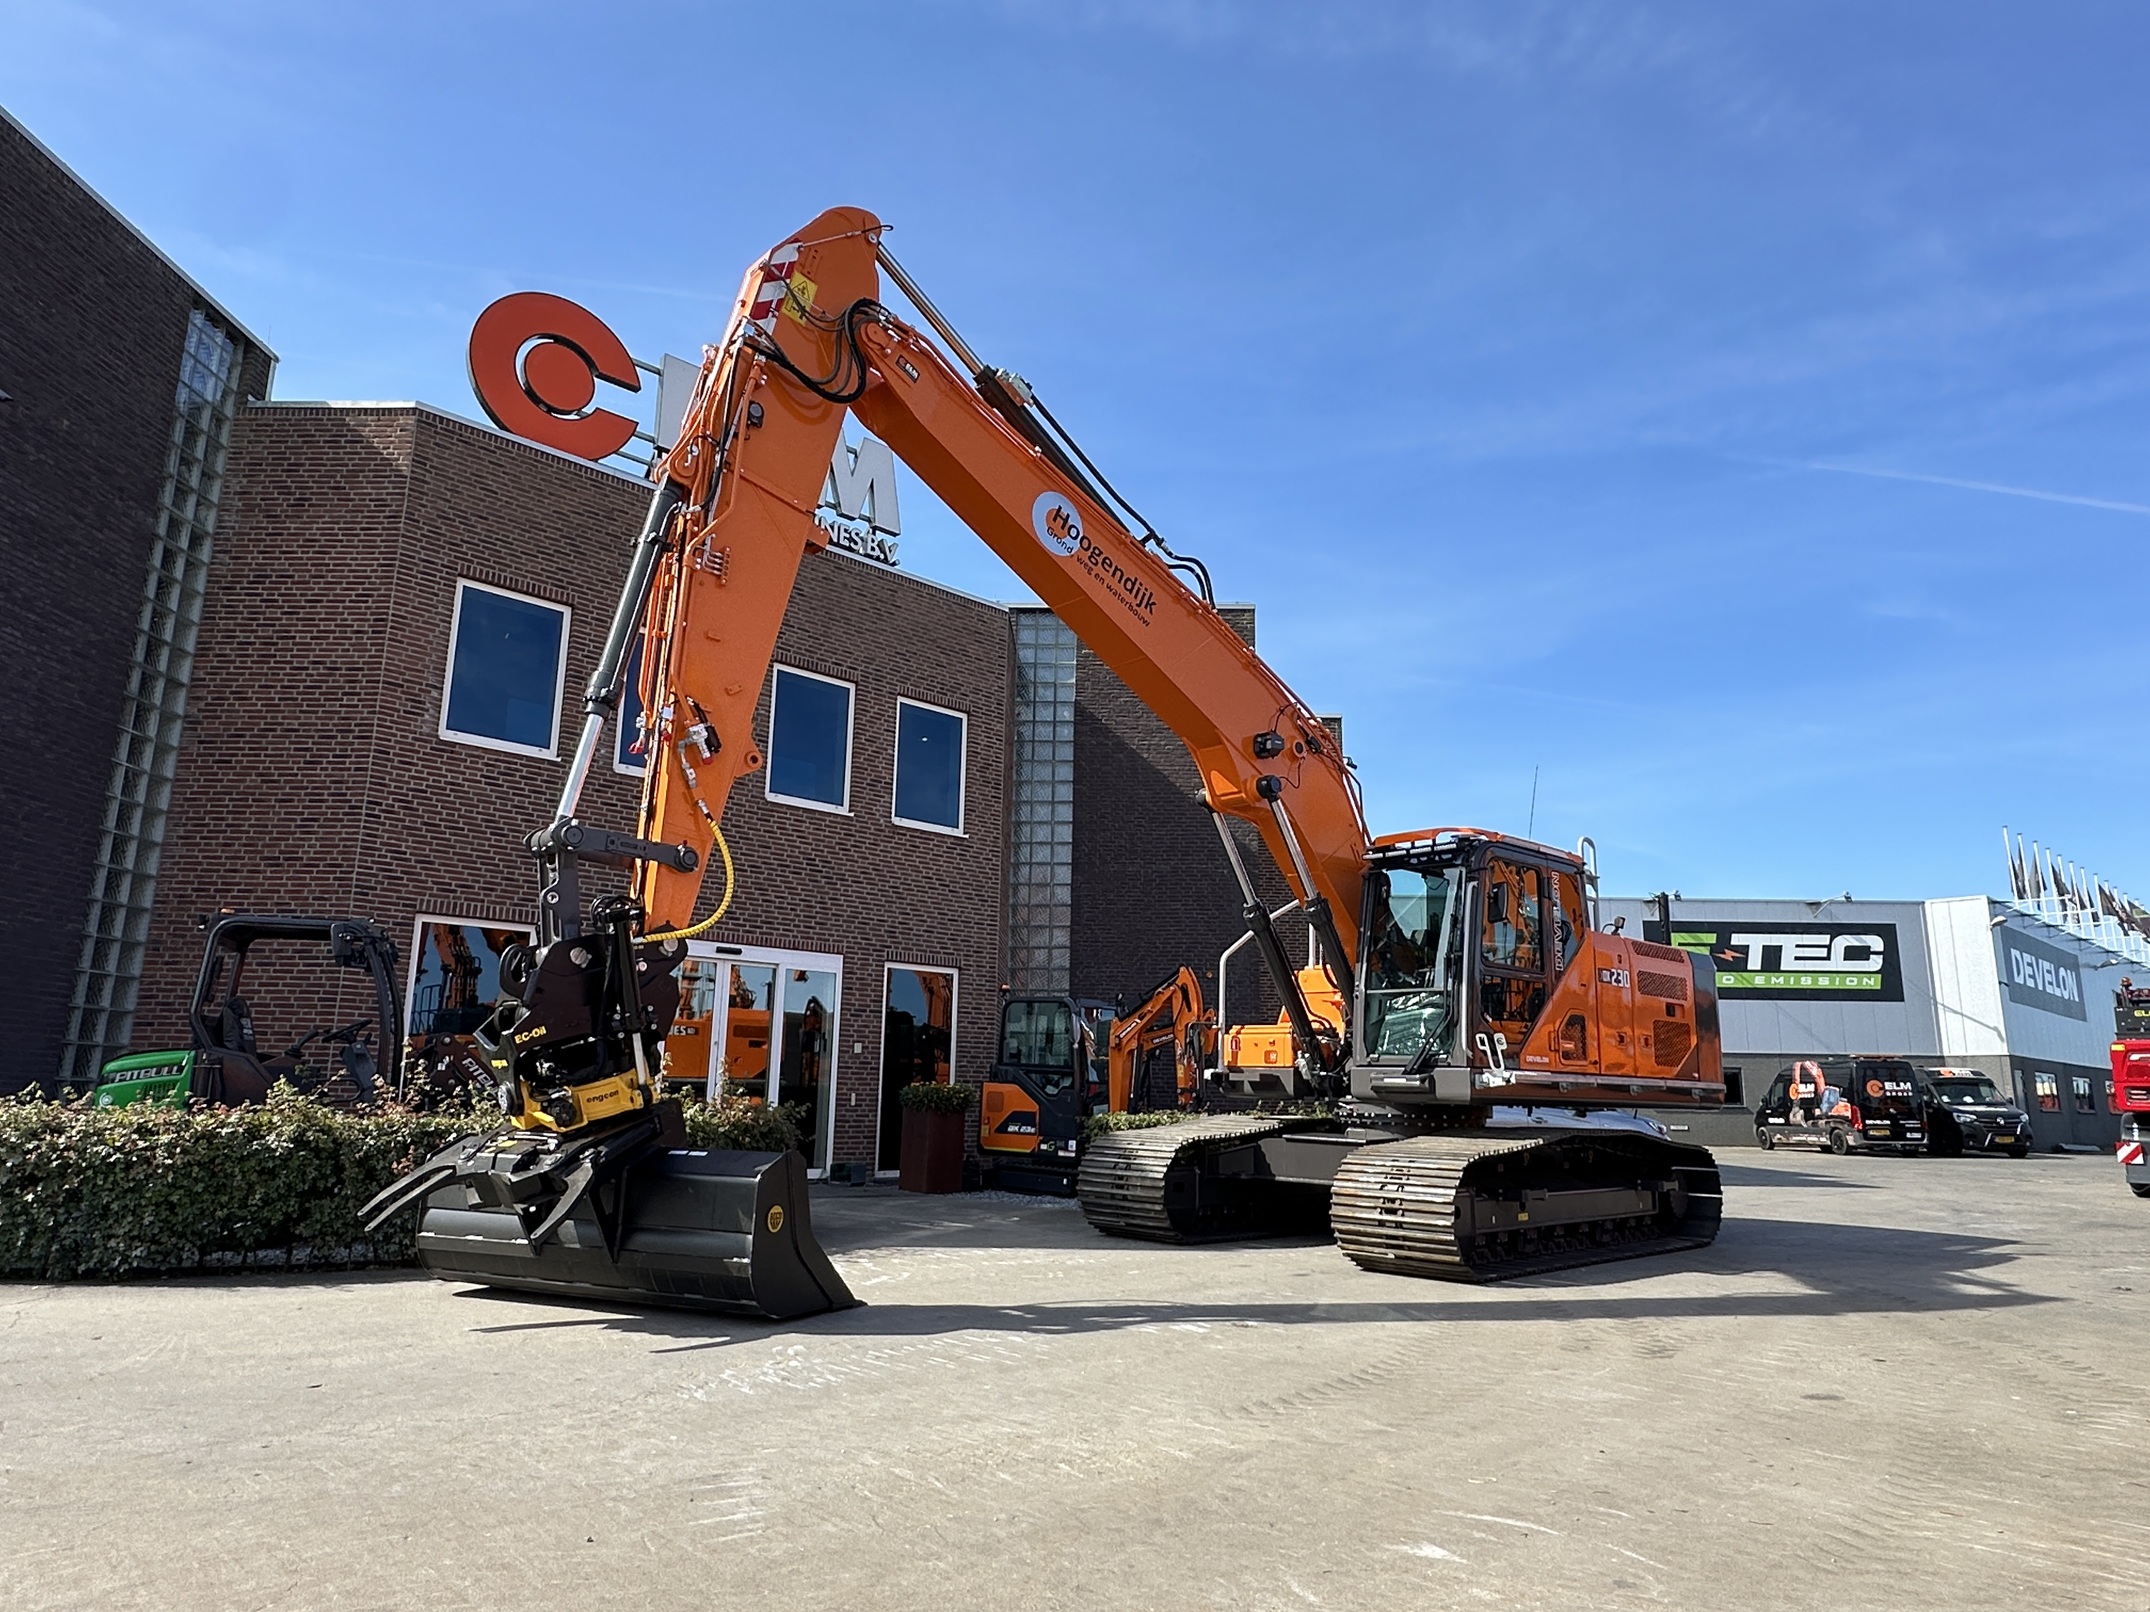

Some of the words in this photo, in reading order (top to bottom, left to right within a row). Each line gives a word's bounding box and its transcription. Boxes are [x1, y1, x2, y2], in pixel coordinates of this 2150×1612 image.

[1052, 504, 1157, 616] Hoogendijk
[1076, 555, 1094, 576] weg
[1094, 571, 1106, 586] en
[1105, 582, 1151, 628] waterbouw
[1754, 975, 1876, 986] EMISSION
[2010, 947, 2080, 1003] DEVELON
[514, 1025, 548, 1044] EC-Oil
[115, 1065, 182, 1084] PITBULL
[586, 1089, 620, 1105] engcon
